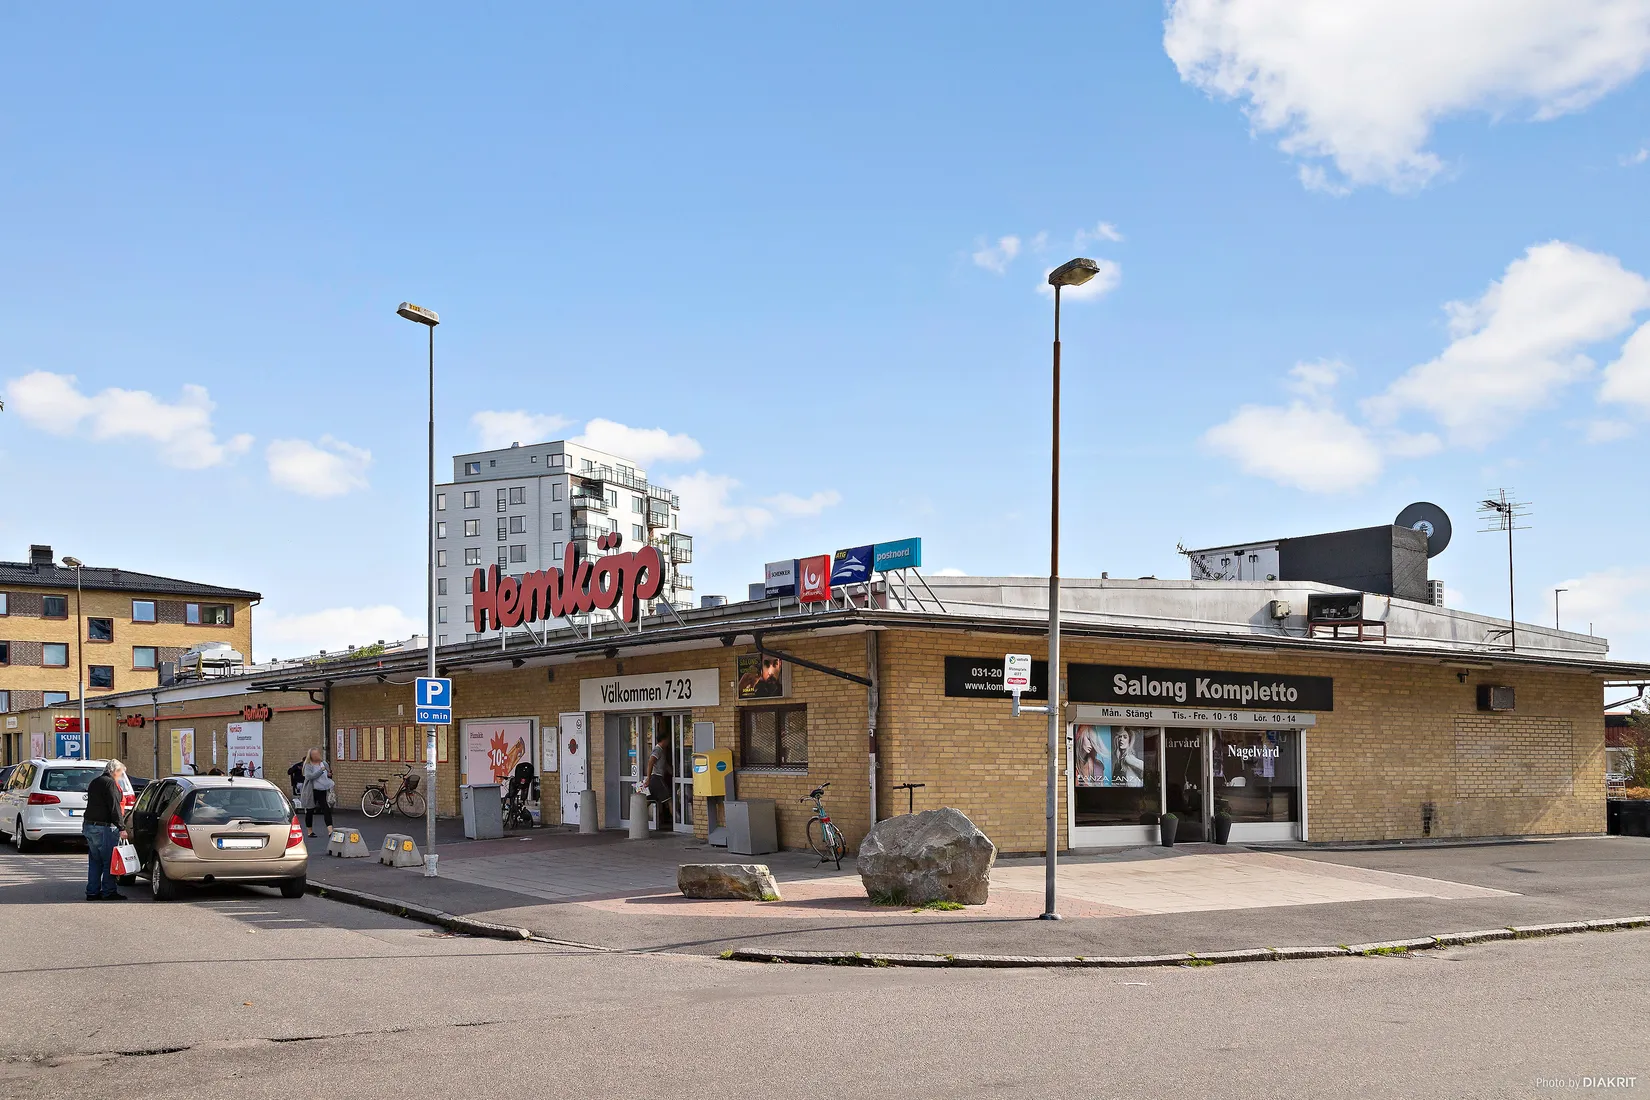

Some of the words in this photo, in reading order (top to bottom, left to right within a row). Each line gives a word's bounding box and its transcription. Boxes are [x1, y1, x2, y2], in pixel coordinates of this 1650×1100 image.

[835, 550, 847, 560] ATG
[876, 548, 910, 562] postnord
[473, 532, 664, 633] Hemköp
[971, 667, 1002, 678] 031-20
[427, 681, 443, 704] P
[601, 682, 661, 703] Välkommen
[665, 679, 692, 700] 7-23
[1113, 674, 1187, 702] Salong
[1195, 678, 1298, 704] Kompletto
[432, 712, 448, 720] min
[1101, 708, 1122, 717] Mån.
[1126, 709, 1153, 719] Stängt
[1172, 711, 1187, 720] Tis.
[1193, 712, 1208, 720] Fre.
[1229, 713, 1238, 721] 18
[1253, 714, 1267, 722] Lör.
[1272, 714, 1281, 722] 10
[65, 741, 80, 756] P
[1228, 744, 1280, 760] Nagelvård
